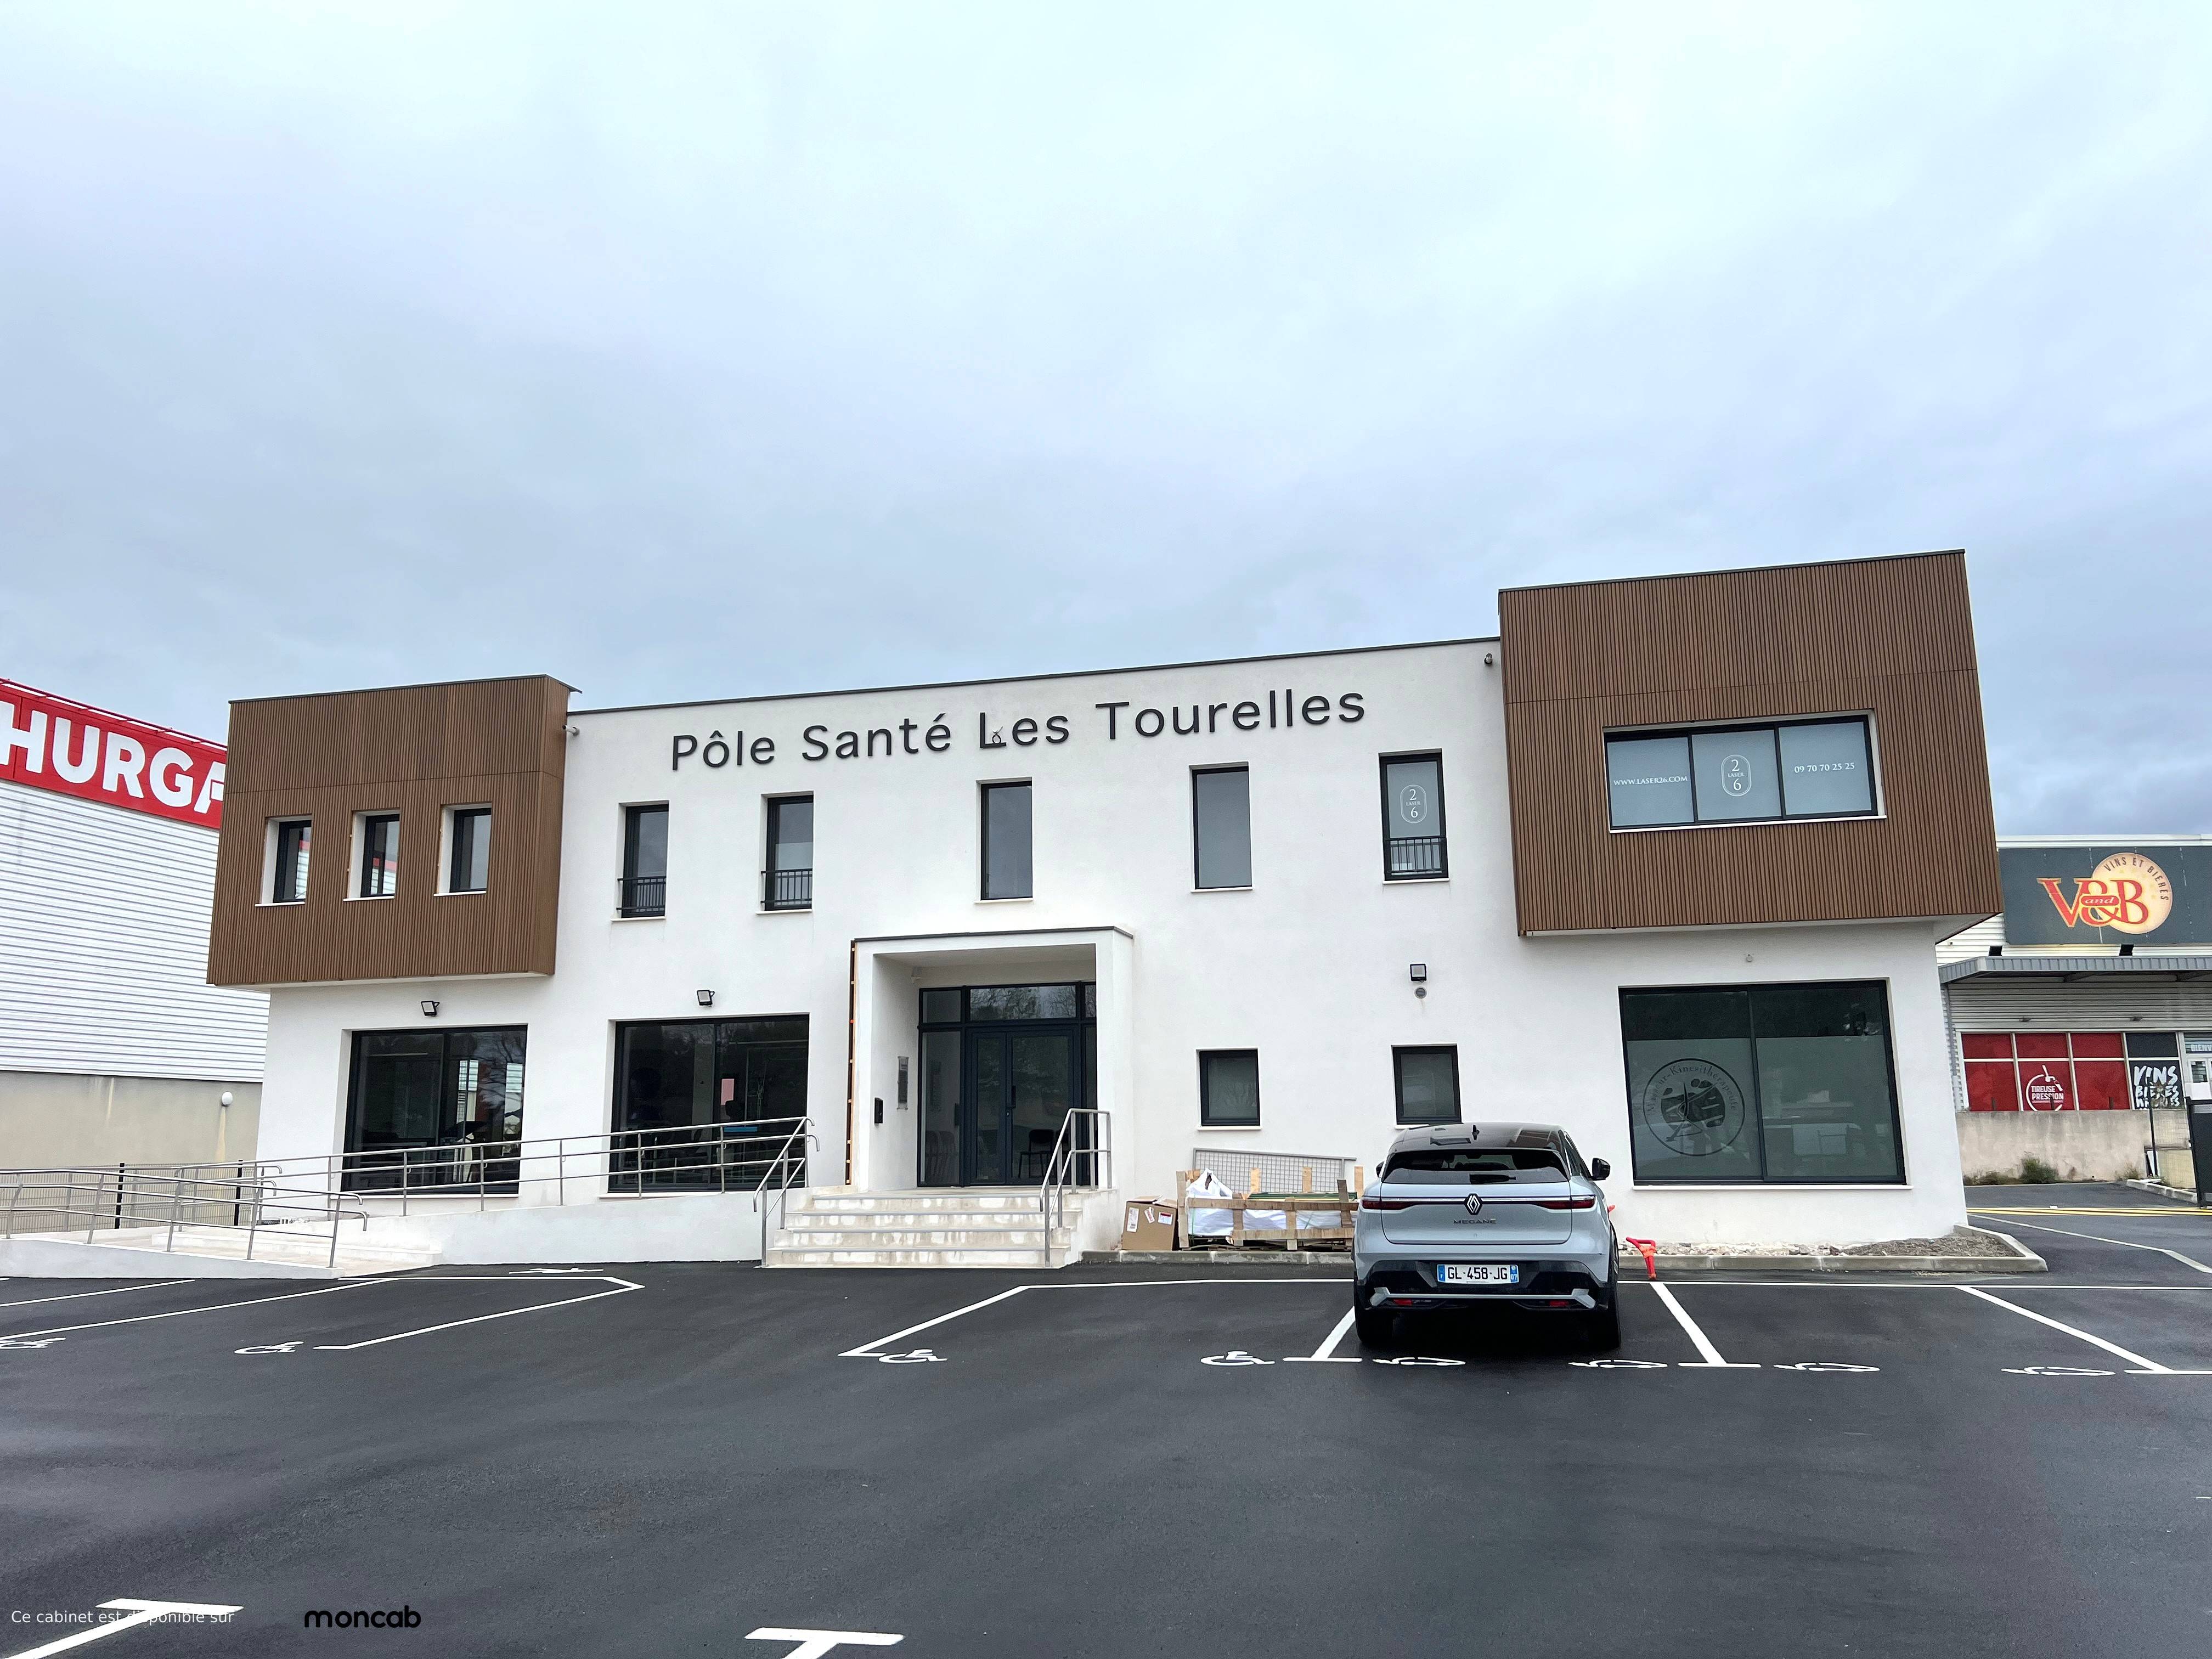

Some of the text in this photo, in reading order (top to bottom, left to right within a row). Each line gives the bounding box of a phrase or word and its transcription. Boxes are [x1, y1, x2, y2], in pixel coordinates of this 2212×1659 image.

[673, 689, 1365, 770] Pôle Santé Les Tourelles
[1731, 759, 1740, 772] 2
[1613, 776, 1688, 786] WWW.LASER26.COM
[1733, 778, 1742, 791] 6
[1409, 789, 1417, 800] 2
[1410, 806, 1418, 818] 6
[2103, 857, 2169, 900] VINS ET BIERES
[2134, 1065, 2178, 1086] VINS
[1447, 1267, 1508, 1280] GL-458-JG
